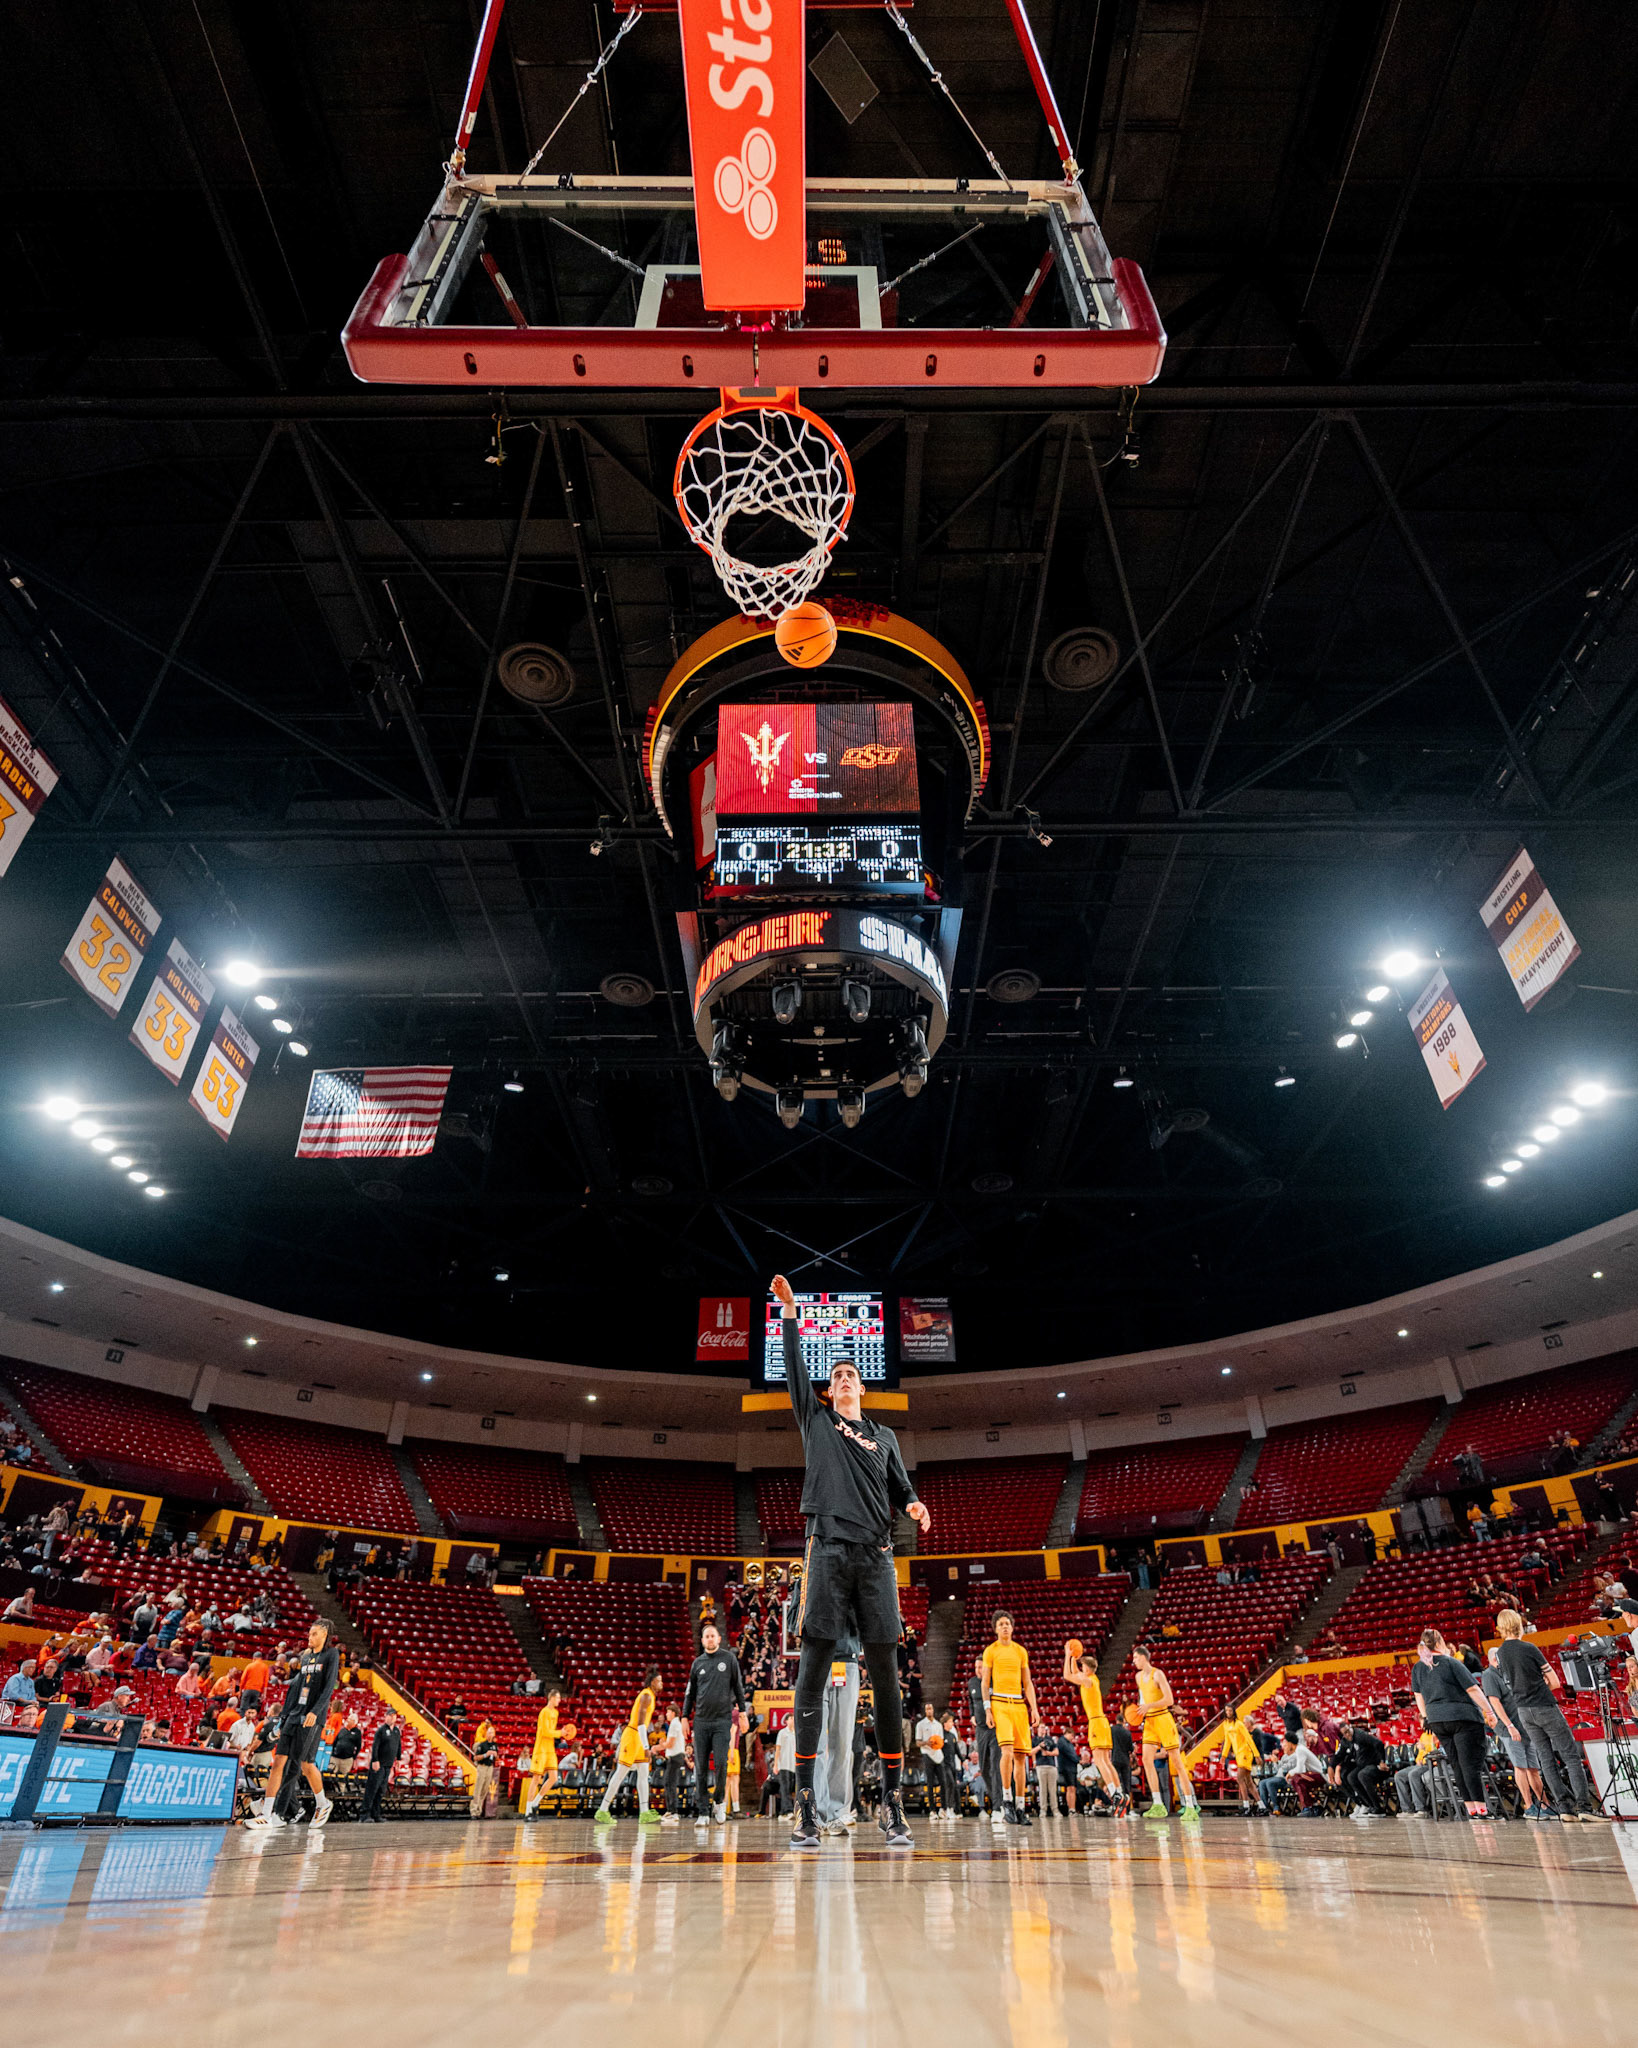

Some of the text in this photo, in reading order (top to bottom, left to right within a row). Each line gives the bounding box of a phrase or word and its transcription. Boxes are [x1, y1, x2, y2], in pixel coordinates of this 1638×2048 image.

[738, 842, 757, 860] 0
[786, 843, 851, 858] 21:32
[881, 840, 900, 858] 0
[1492, 869, 1522, 908] WRESTLING
[102, 887, 145, 947] CALDWELL
[1505, 892, 1528, 925] CULP
[79, 914, 131, 996] 32
[1519, 931, 1566, 987] HEAVYWEIGHT
[167, 968, 201, 1012] HOLLINS
[145, 991, 192, 1061] 33
[1421, 997, 1446, 1031] NATIONAL
[1422, 1001, 1452, 1042] CHAMPIONS
[222, 1037, 245, 1070] LISTER
[1433, 1022, 1456, 1057] 1988
[202, 1056, 240, 1118] 53
[805, 1307, 844, 1318] 21:32
[858, 1306, 869, 1319] 0
[763, 1694, 792, 1702] ABANDON
[123, 1762, 231, 1806] ROGRESSIVE
